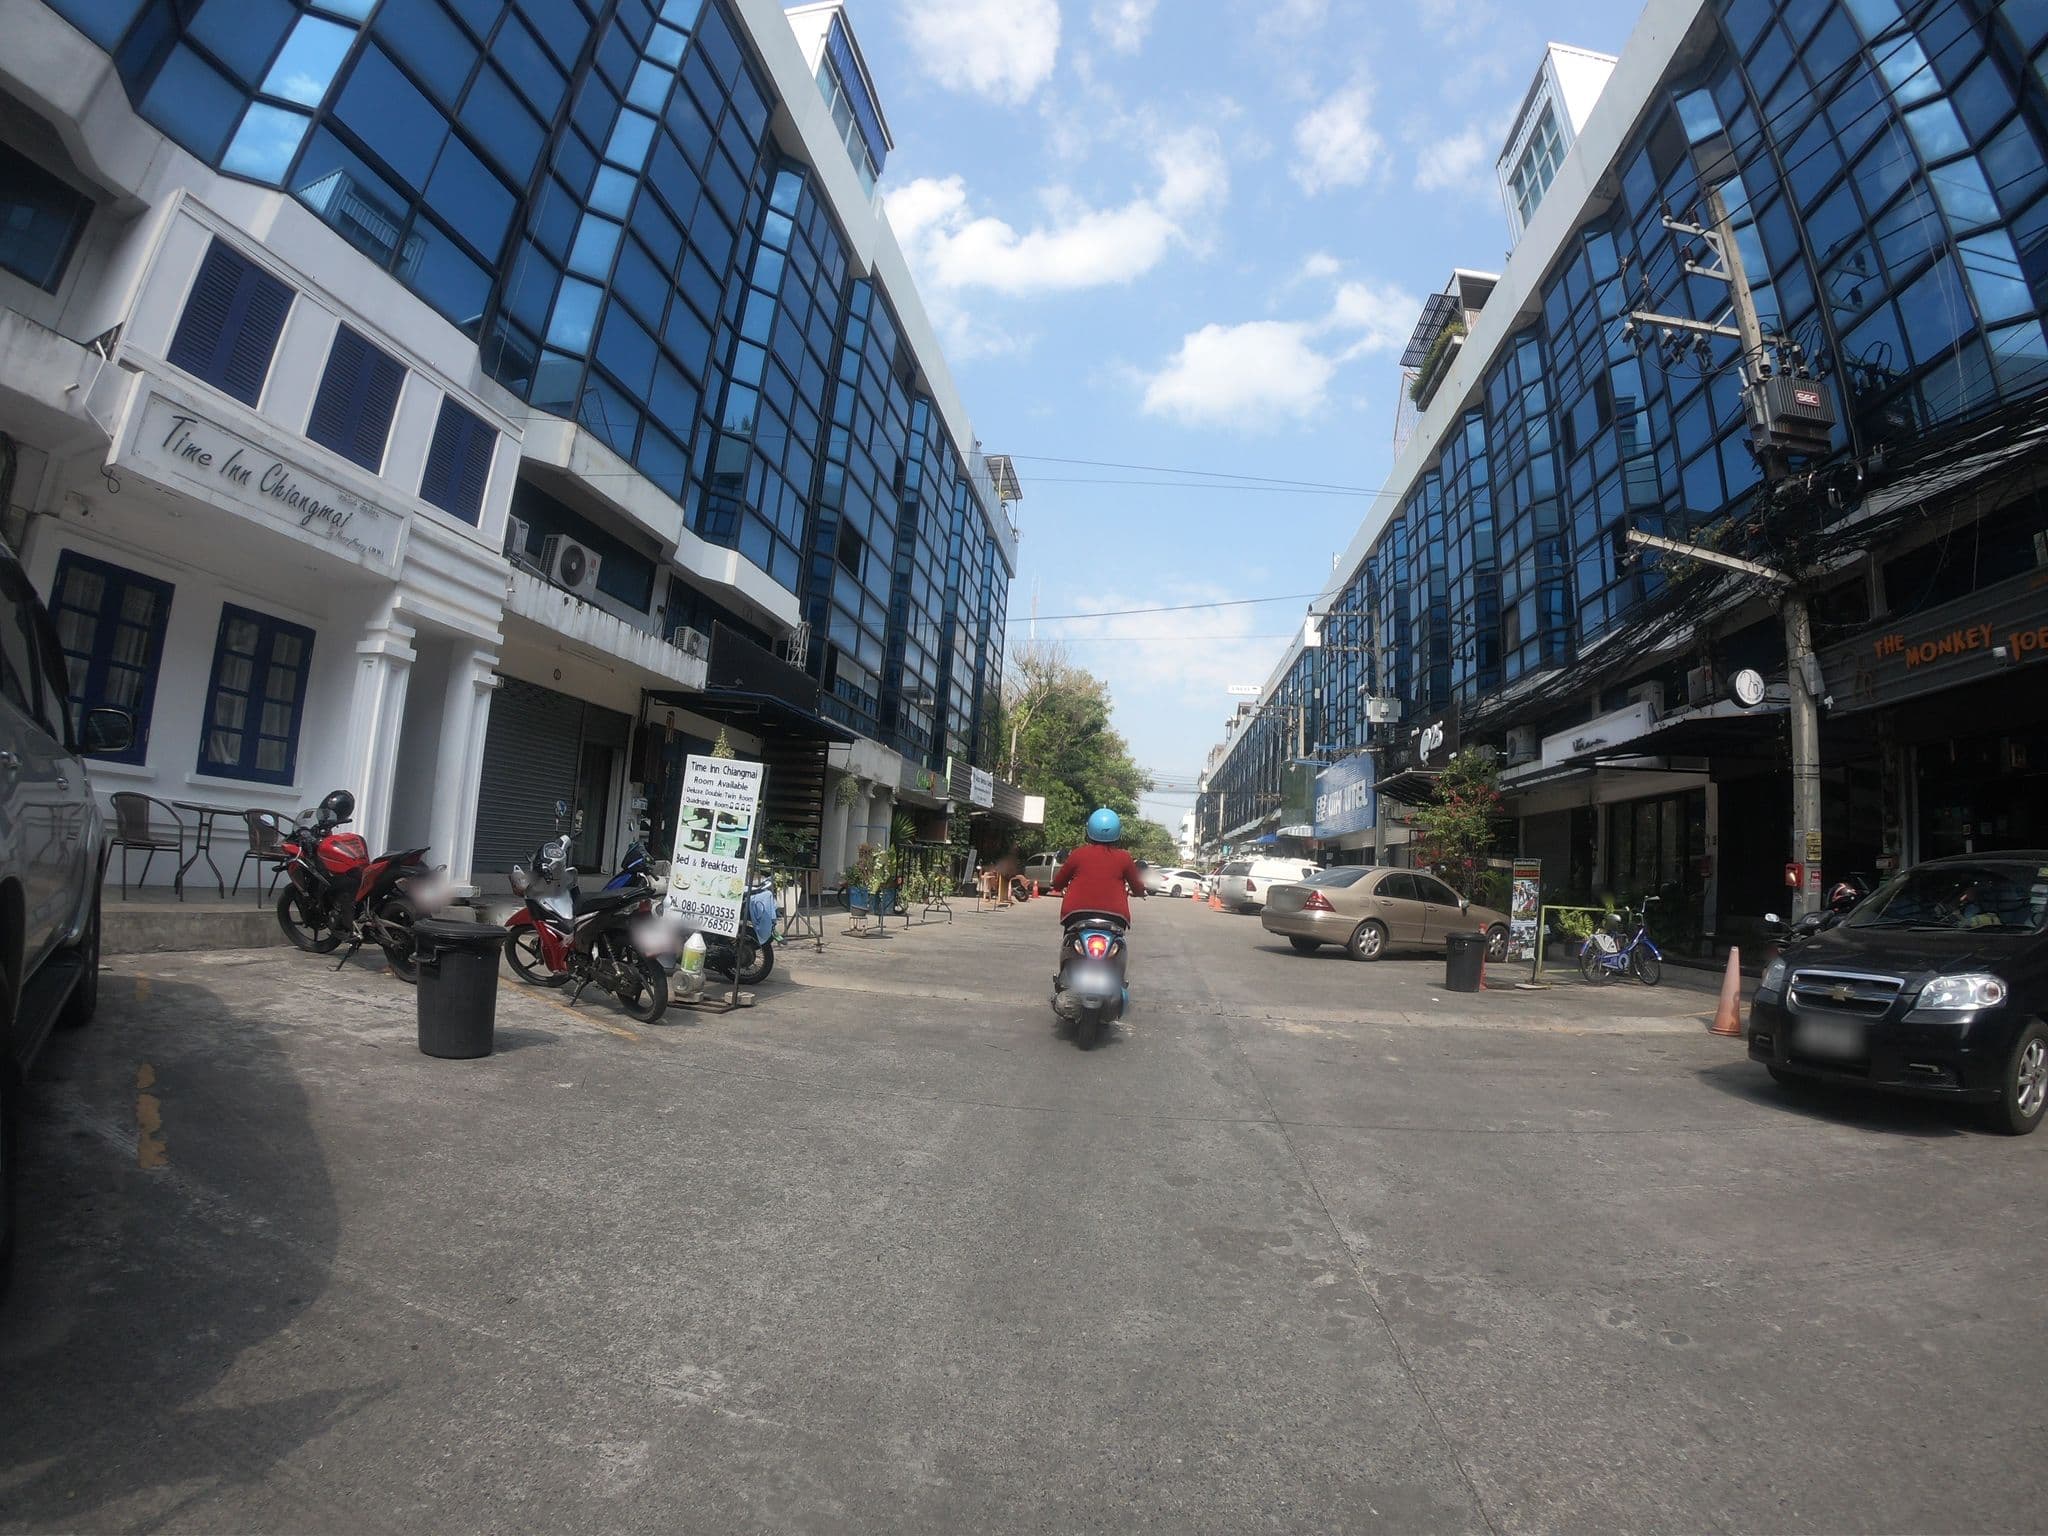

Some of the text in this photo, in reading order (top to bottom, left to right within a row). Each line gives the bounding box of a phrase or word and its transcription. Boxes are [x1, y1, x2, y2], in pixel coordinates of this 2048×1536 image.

[162, 416, 212, 466] Time
[220, 450, 252, 486] Inn
[259, 463, 354, 528] Chiangmai
[1874, 634, 1905, 659] THE
[1904, 623, 1993, 670] MONKEY
[691, 761, 758, 780] Time Inn Chiangmai
[693, 776, 749, 791] Room Available
[714, 801, 729, 809] Room
[739, 794, 753, 802] Room
[676, 853, 690, 865] Bed
[700, 857, 738, 874] Breakfasts
[681, 899, 735, 919] 080-5003535
